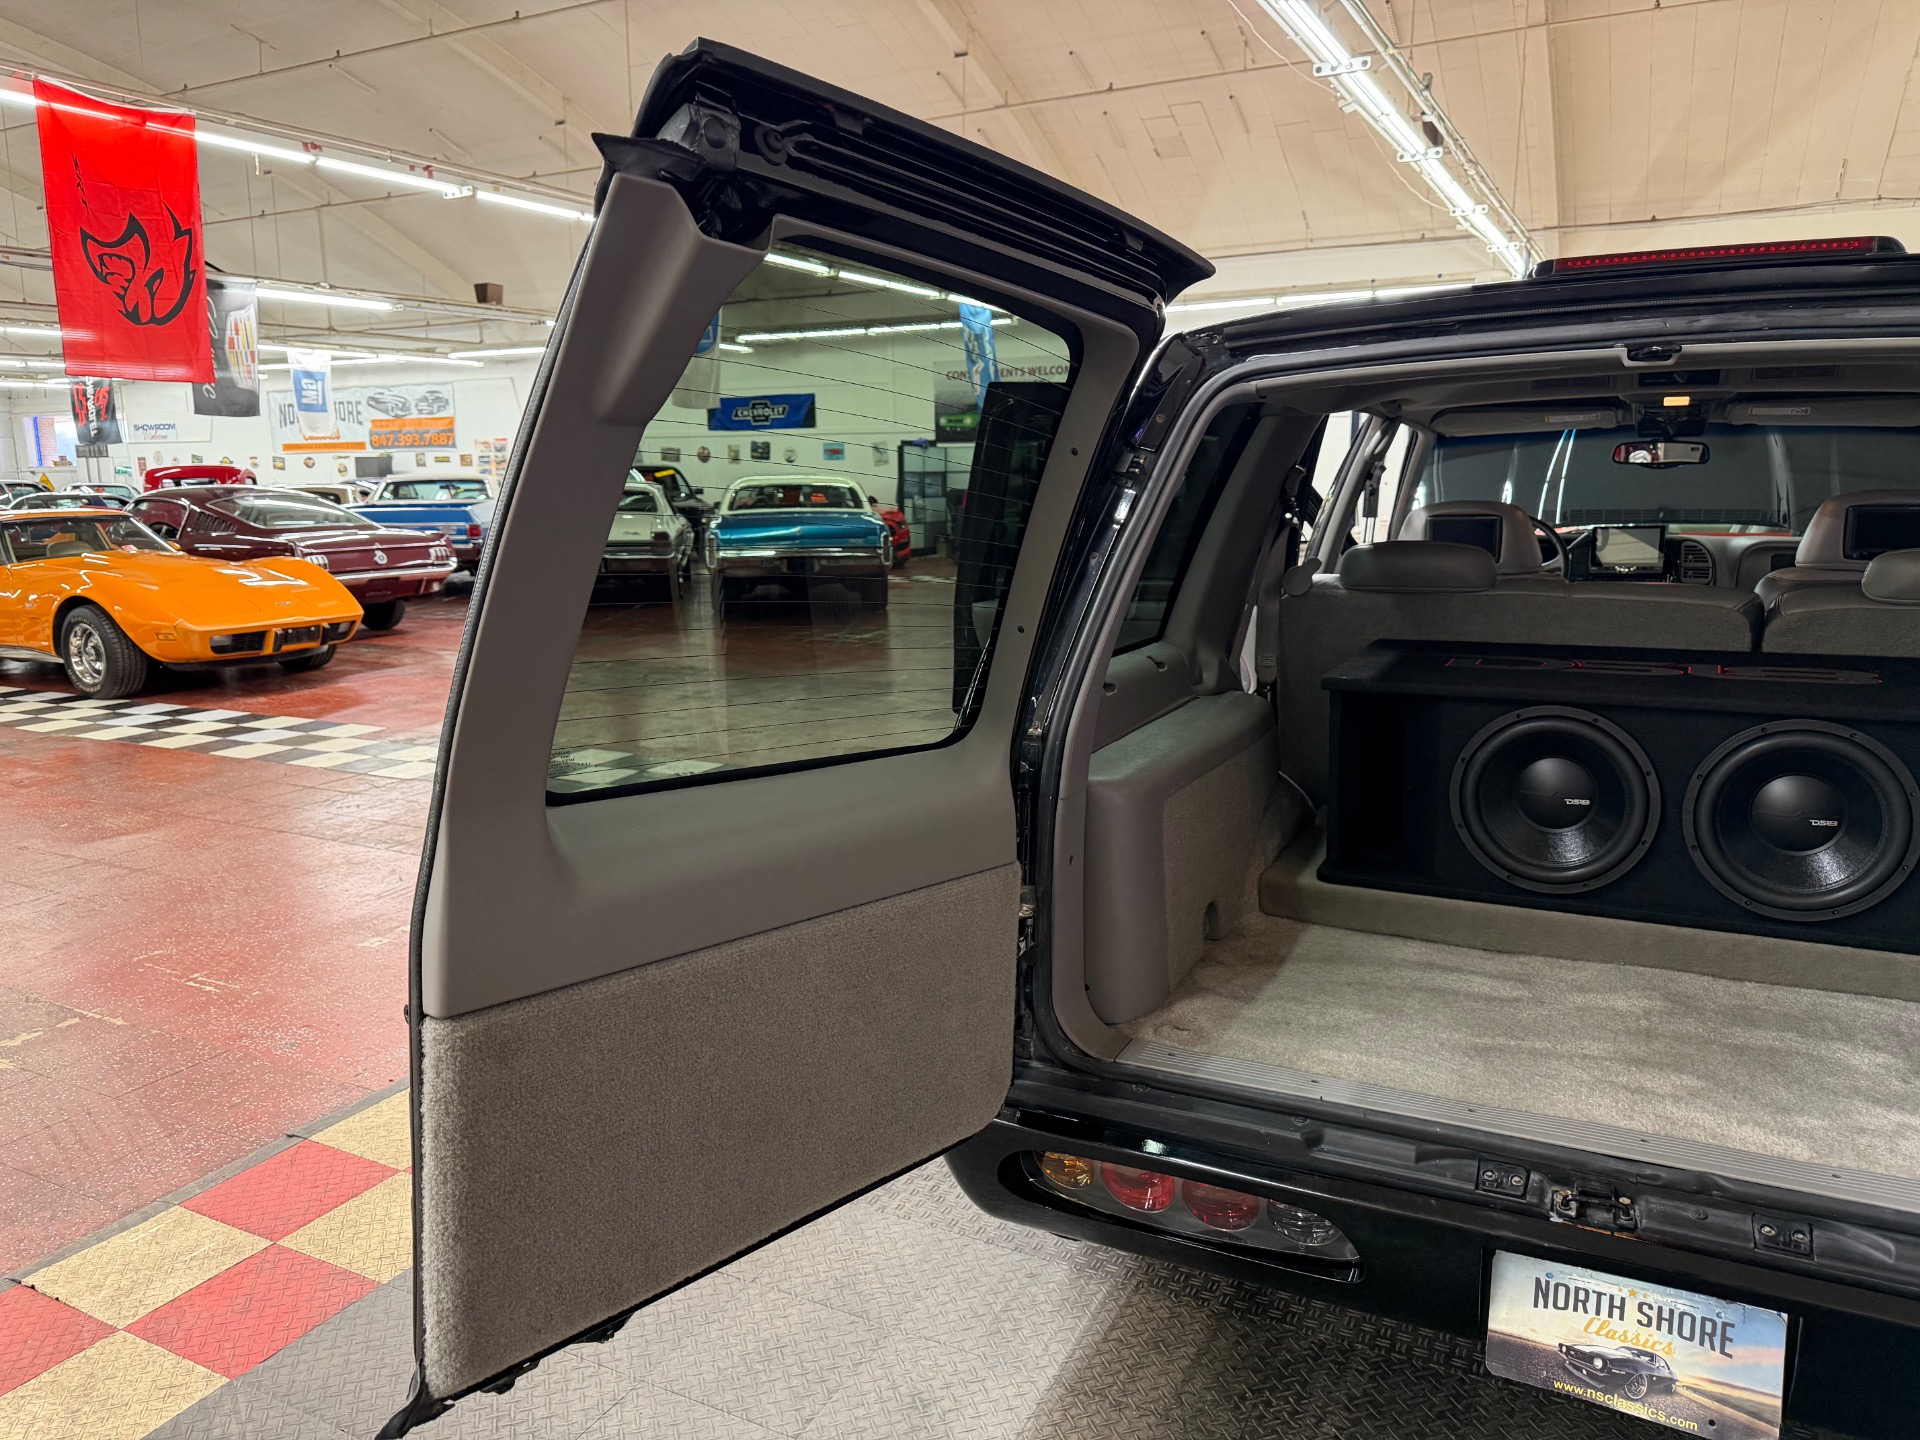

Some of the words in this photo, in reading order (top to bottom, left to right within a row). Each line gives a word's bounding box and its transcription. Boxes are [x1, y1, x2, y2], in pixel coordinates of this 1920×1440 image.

[333, 400, 364, 426] ORE
[736, 407, 785, 417] CHEVROLET
[133, 422, 176, 431] SHOWROOM
[371, 432, 455, 447] 847.393.7887
[1533, 1277, 1626, 1322] NORTH
[1636, 1301, 1736, 1359] SHORE
[1583, 1316, 1675, 1355] Classics
[1553, 1380, 1699, 1432] www.nsclassics.com
